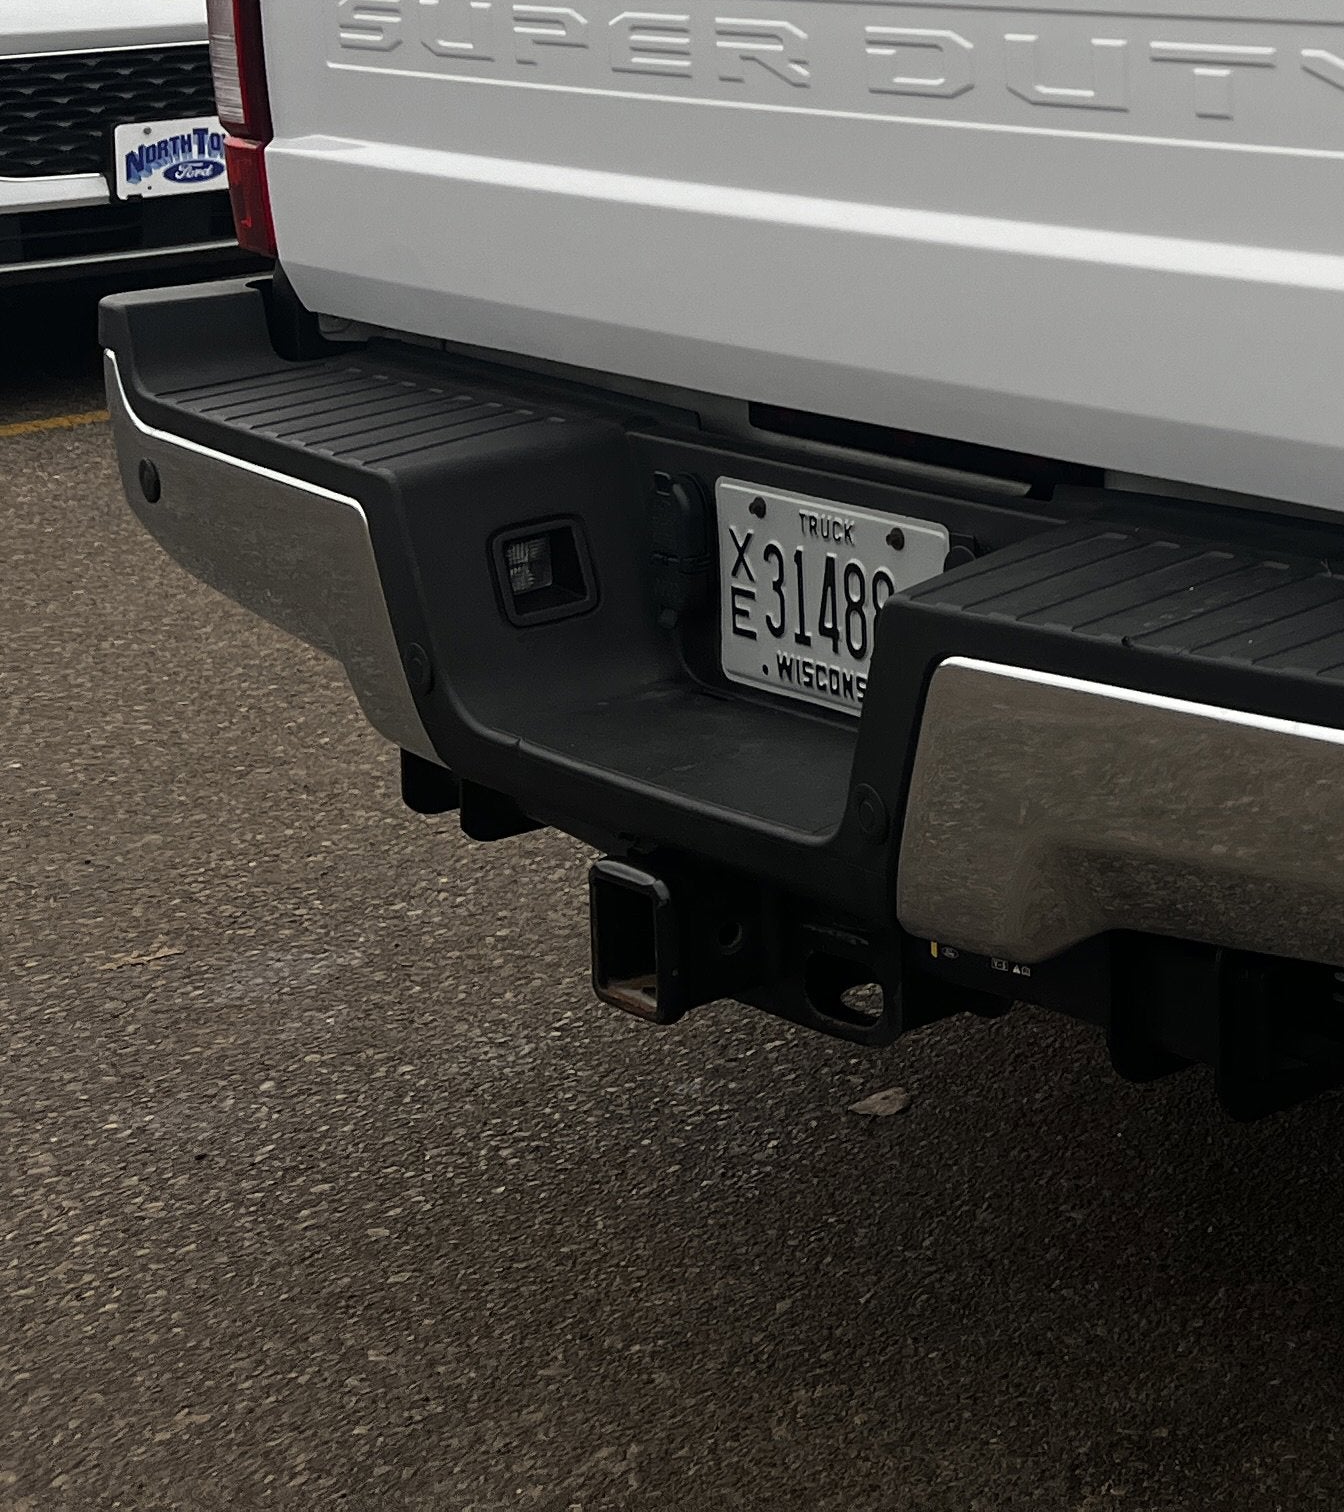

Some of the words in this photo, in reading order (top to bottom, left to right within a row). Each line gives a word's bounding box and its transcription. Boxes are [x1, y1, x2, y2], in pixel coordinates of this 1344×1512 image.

[193, 128, 225, 158] TO
[175, 162, 214, 180] Ford
[799, 512, 857, 546] TRUCK
[776, 650, 868, 703] WISCONS
